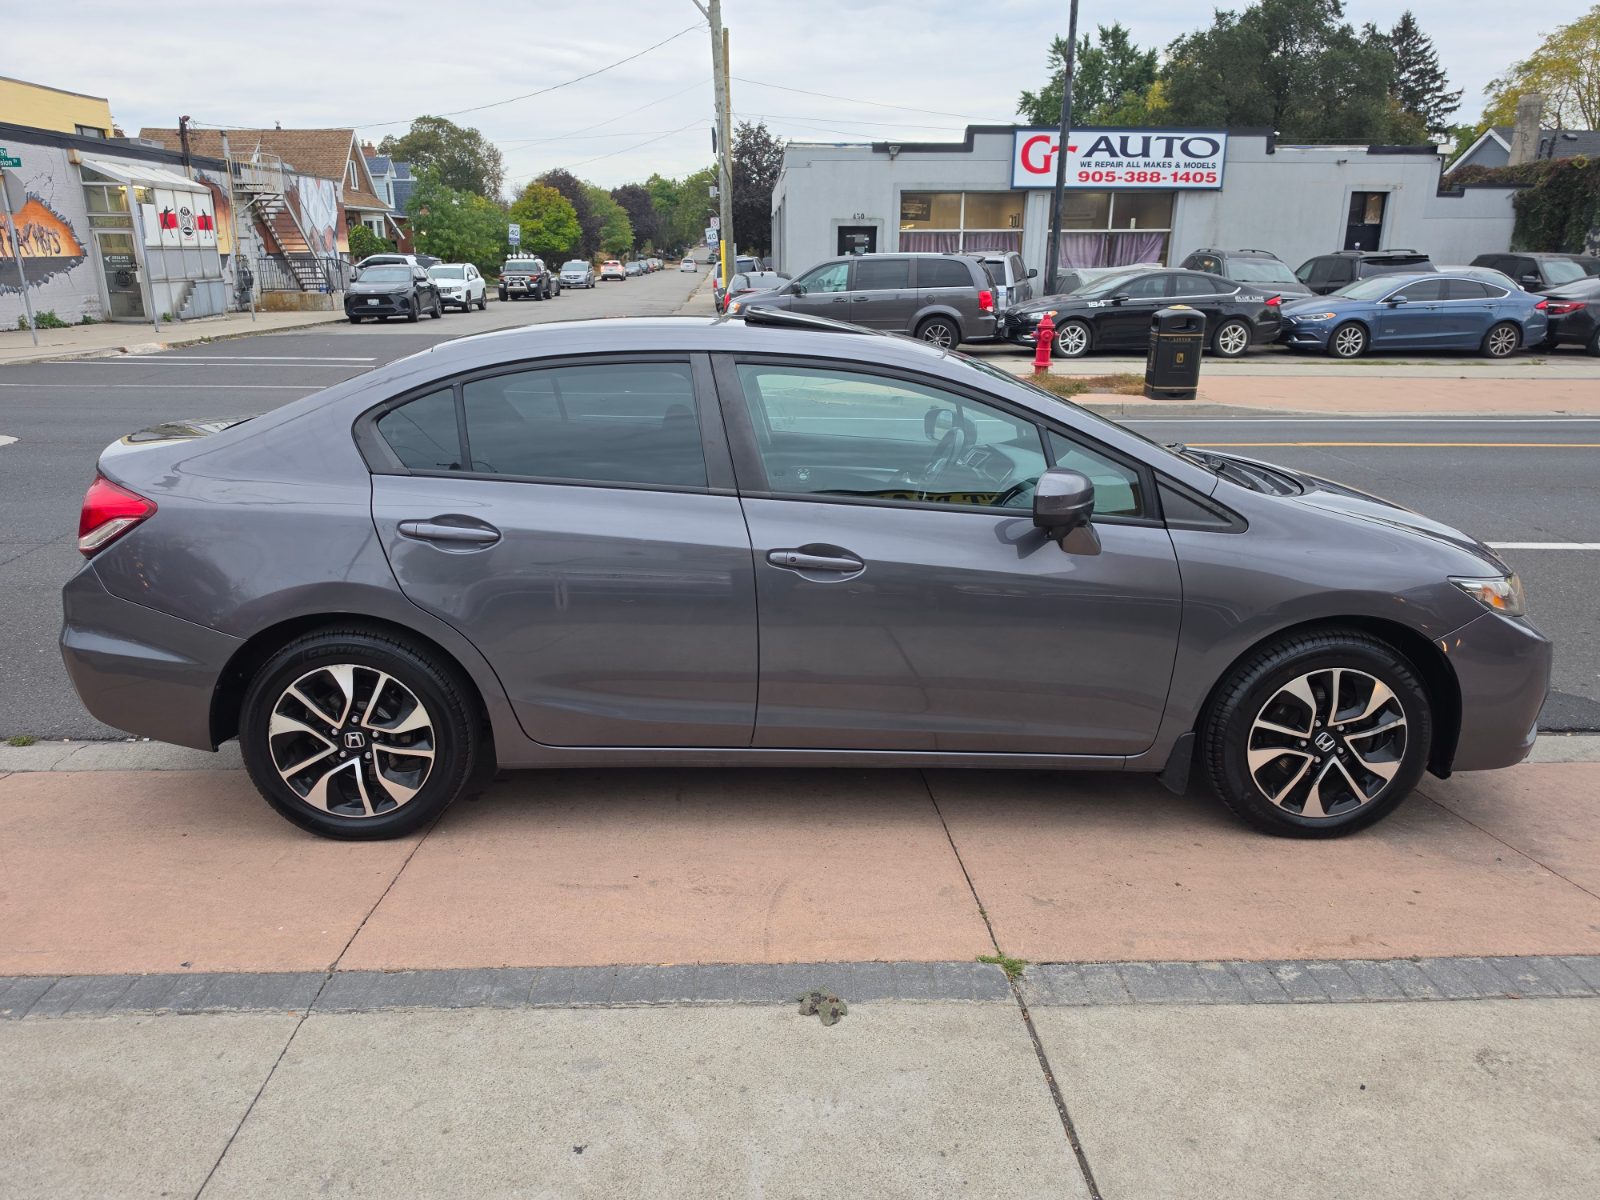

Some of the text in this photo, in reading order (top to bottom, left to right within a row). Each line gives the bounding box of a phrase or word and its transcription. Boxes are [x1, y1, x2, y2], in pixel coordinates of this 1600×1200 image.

[1082, 136, 1221, 159] AUTO
[1143, 161, 1172, 169] MAKES
[1077, 170, 1217, 183] 905-388-1405
